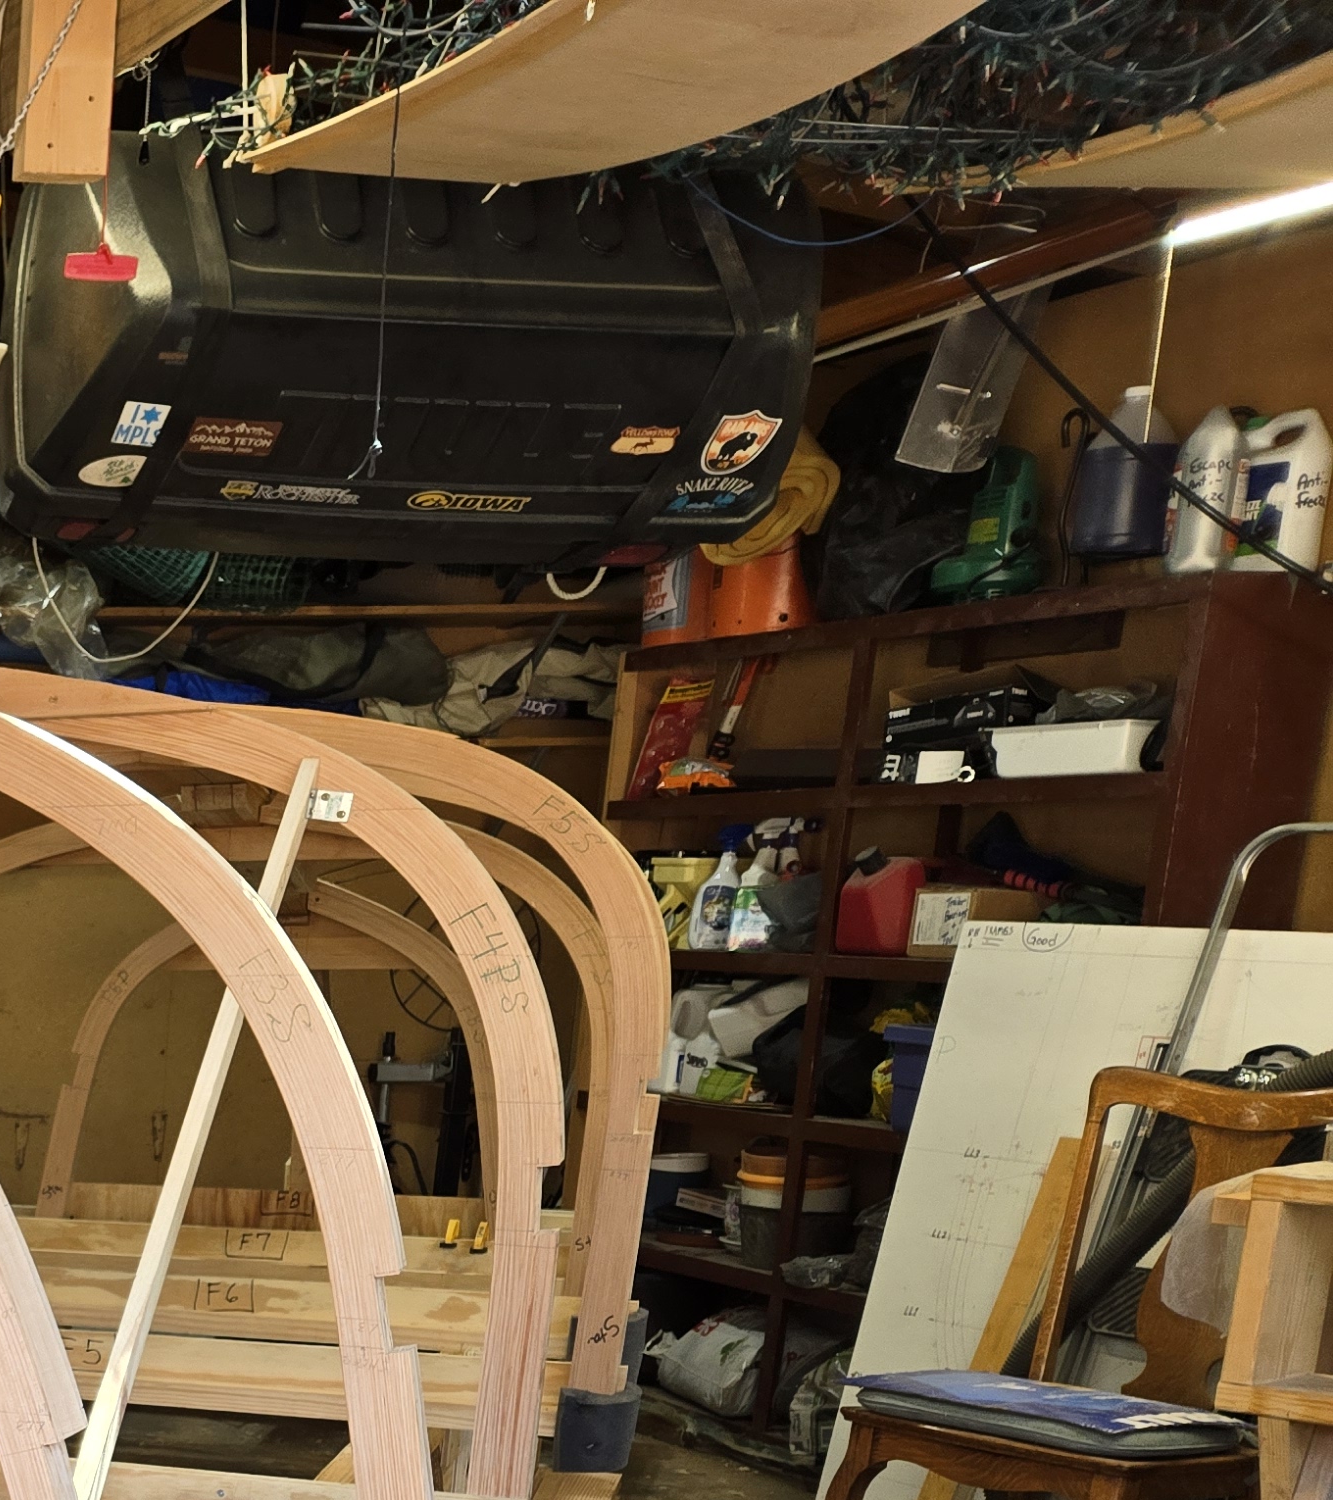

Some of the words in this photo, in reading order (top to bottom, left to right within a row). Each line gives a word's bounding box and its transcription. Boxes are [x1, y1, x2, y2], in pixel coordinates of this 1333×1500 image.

[189, 434, 230, 446] GRAND
[233, 434, 273, 448] TETON
[676, 478, 717, 496] SNAKE
[717, 477, 755, 496] RIVER
[448, 494, 532, 512] IOWA
[1026, 927, 1059, 946] Good
[238, 1232, 271, 1252] F7
[205, 1282, 240, 1306] F6
